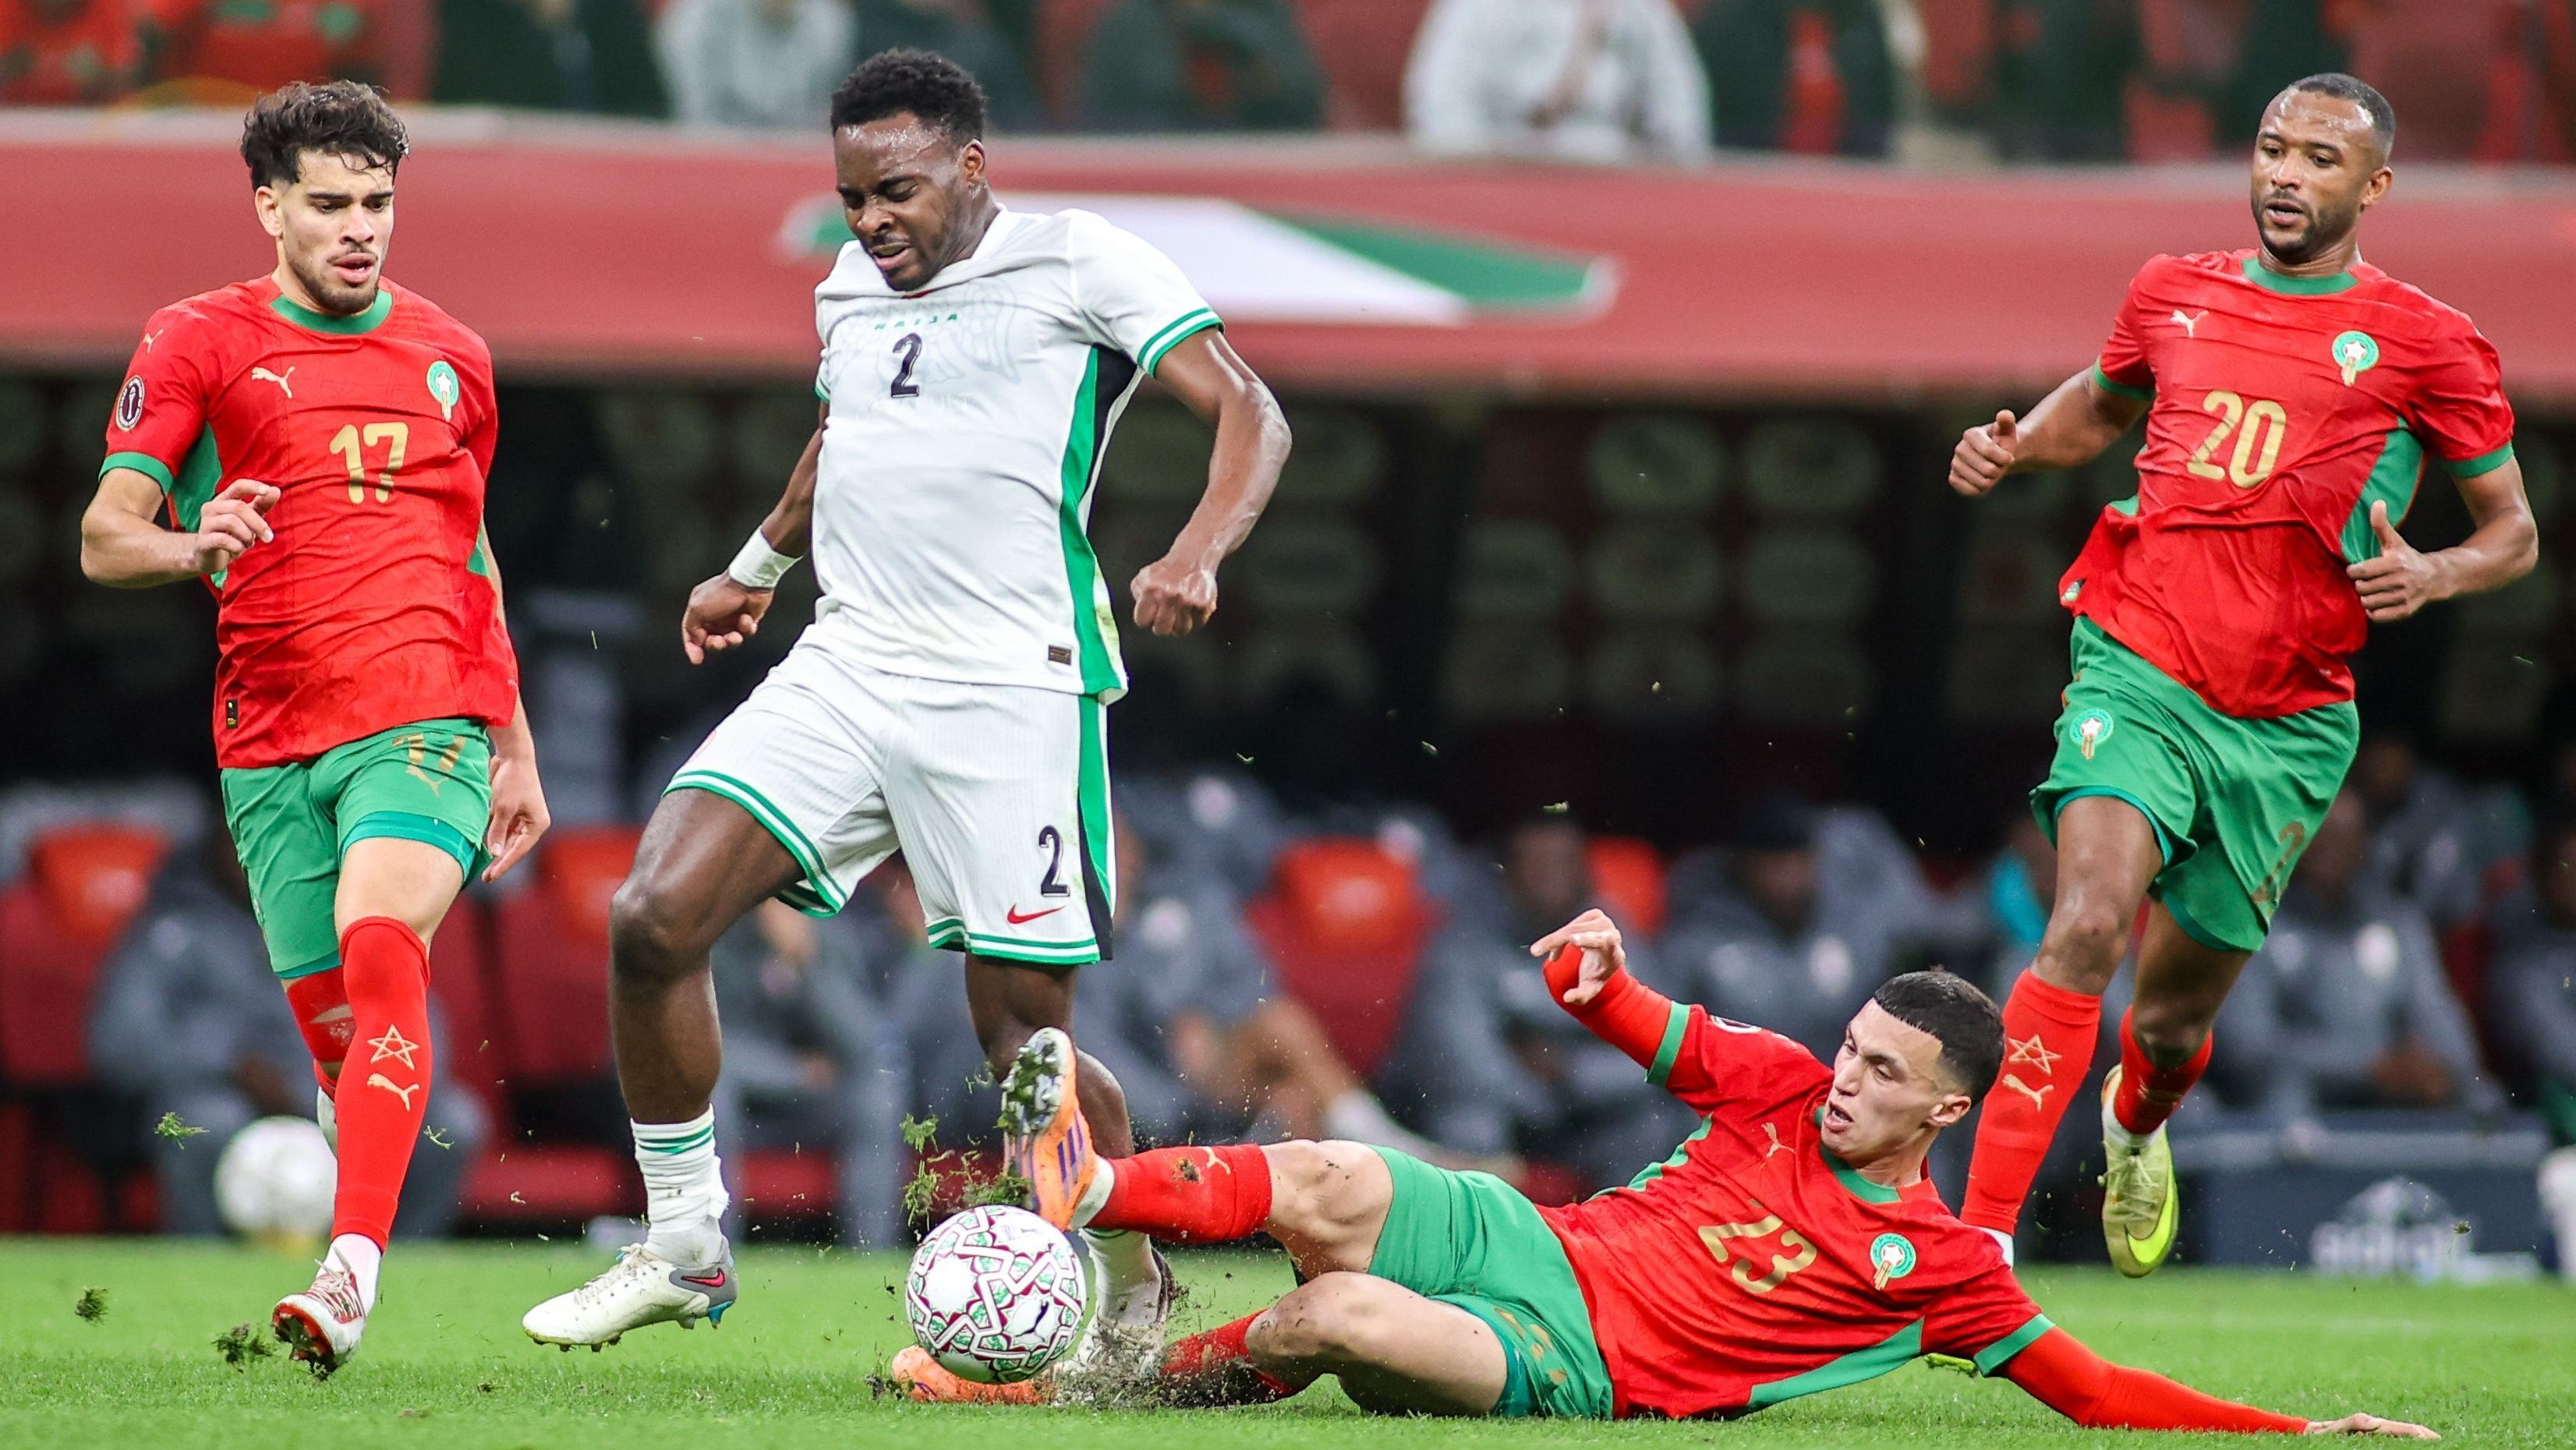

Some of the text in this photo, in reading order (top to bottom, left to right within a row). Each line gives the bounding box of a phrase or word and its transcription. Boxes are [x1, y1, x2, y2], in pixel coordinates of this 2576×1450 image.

[874, 313, 957, 330] NAIJA
[890, 332, 922, 399] 2
[329, 422, 409, 504] 17
[2187, 390, 2287, 489] 20
[1039, 824, 1071, 898] 2
